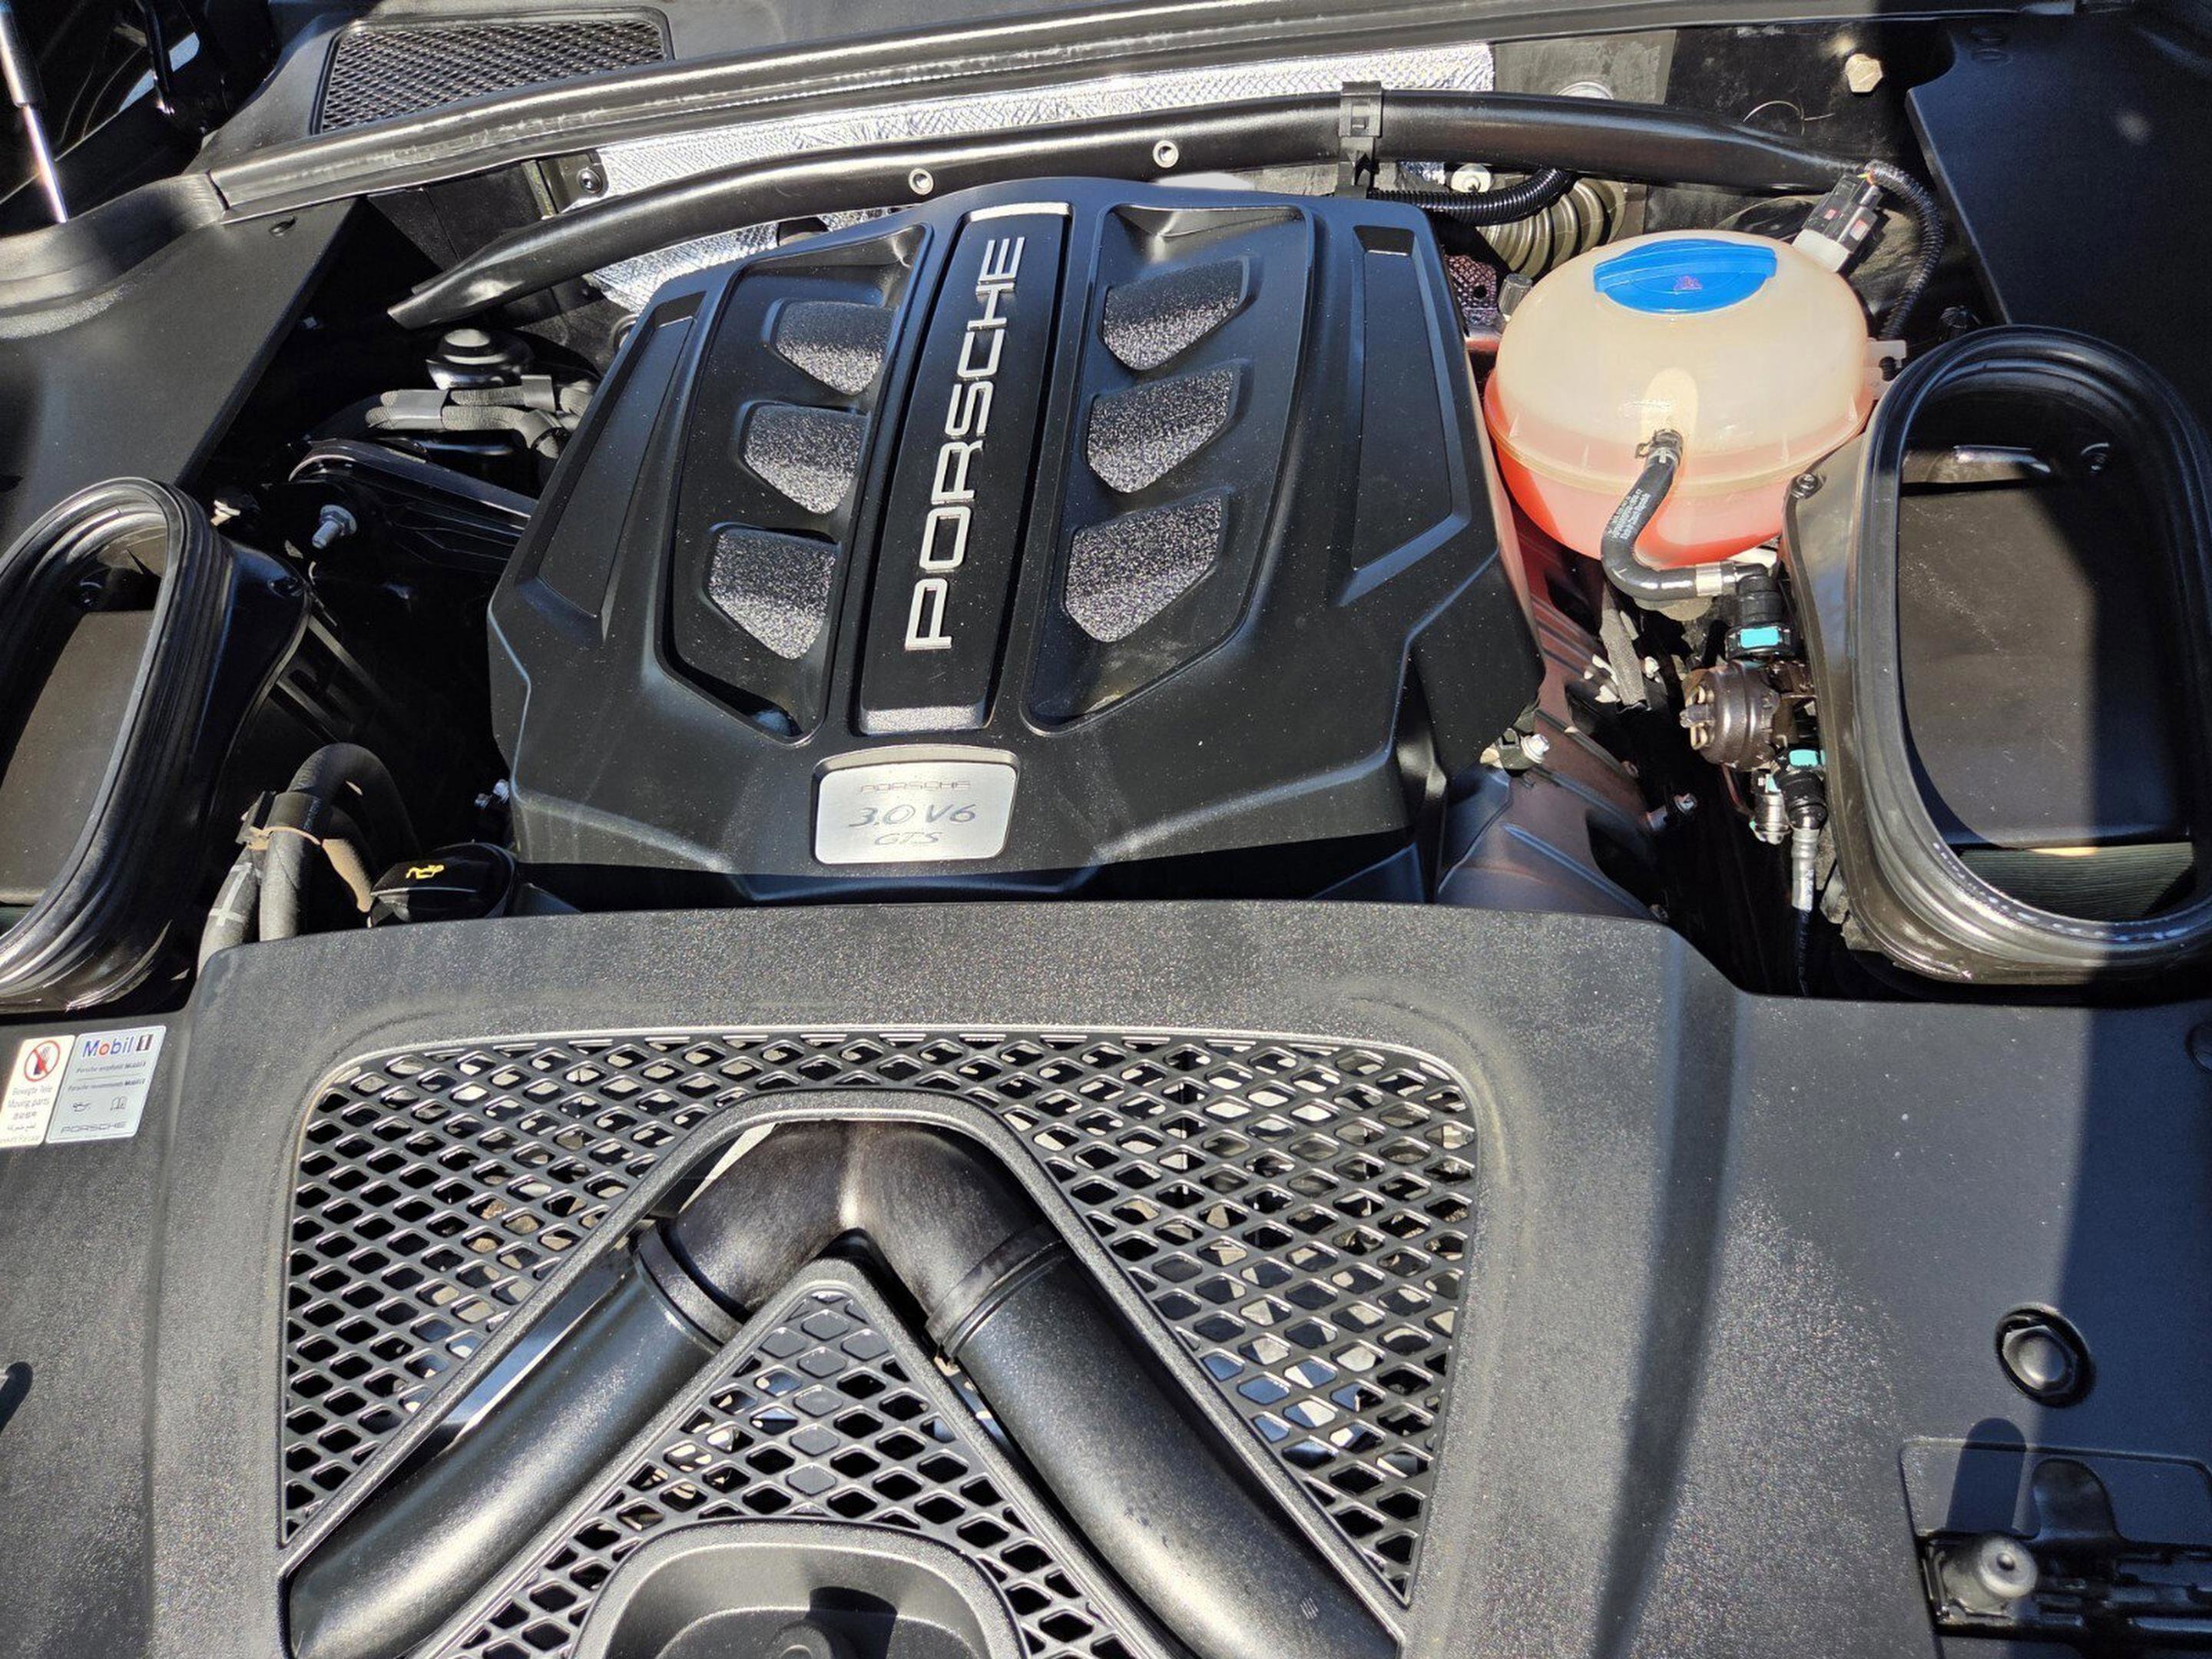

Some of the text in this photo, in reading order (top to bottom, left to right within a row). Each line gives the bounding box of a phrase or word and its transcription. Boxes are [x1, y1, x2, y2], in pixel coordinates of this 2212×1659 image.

[905, 236, 1025, 651] PORSCHE
[860, 780, 972, 793] PORSCHE
[848, 803, 977, 827] 3.0 V6
[875, 832, 943, 846] GTS
[82, 1036, 134, 1058] Mobil
[61, 1121, 127, 1134] PORSCHE
